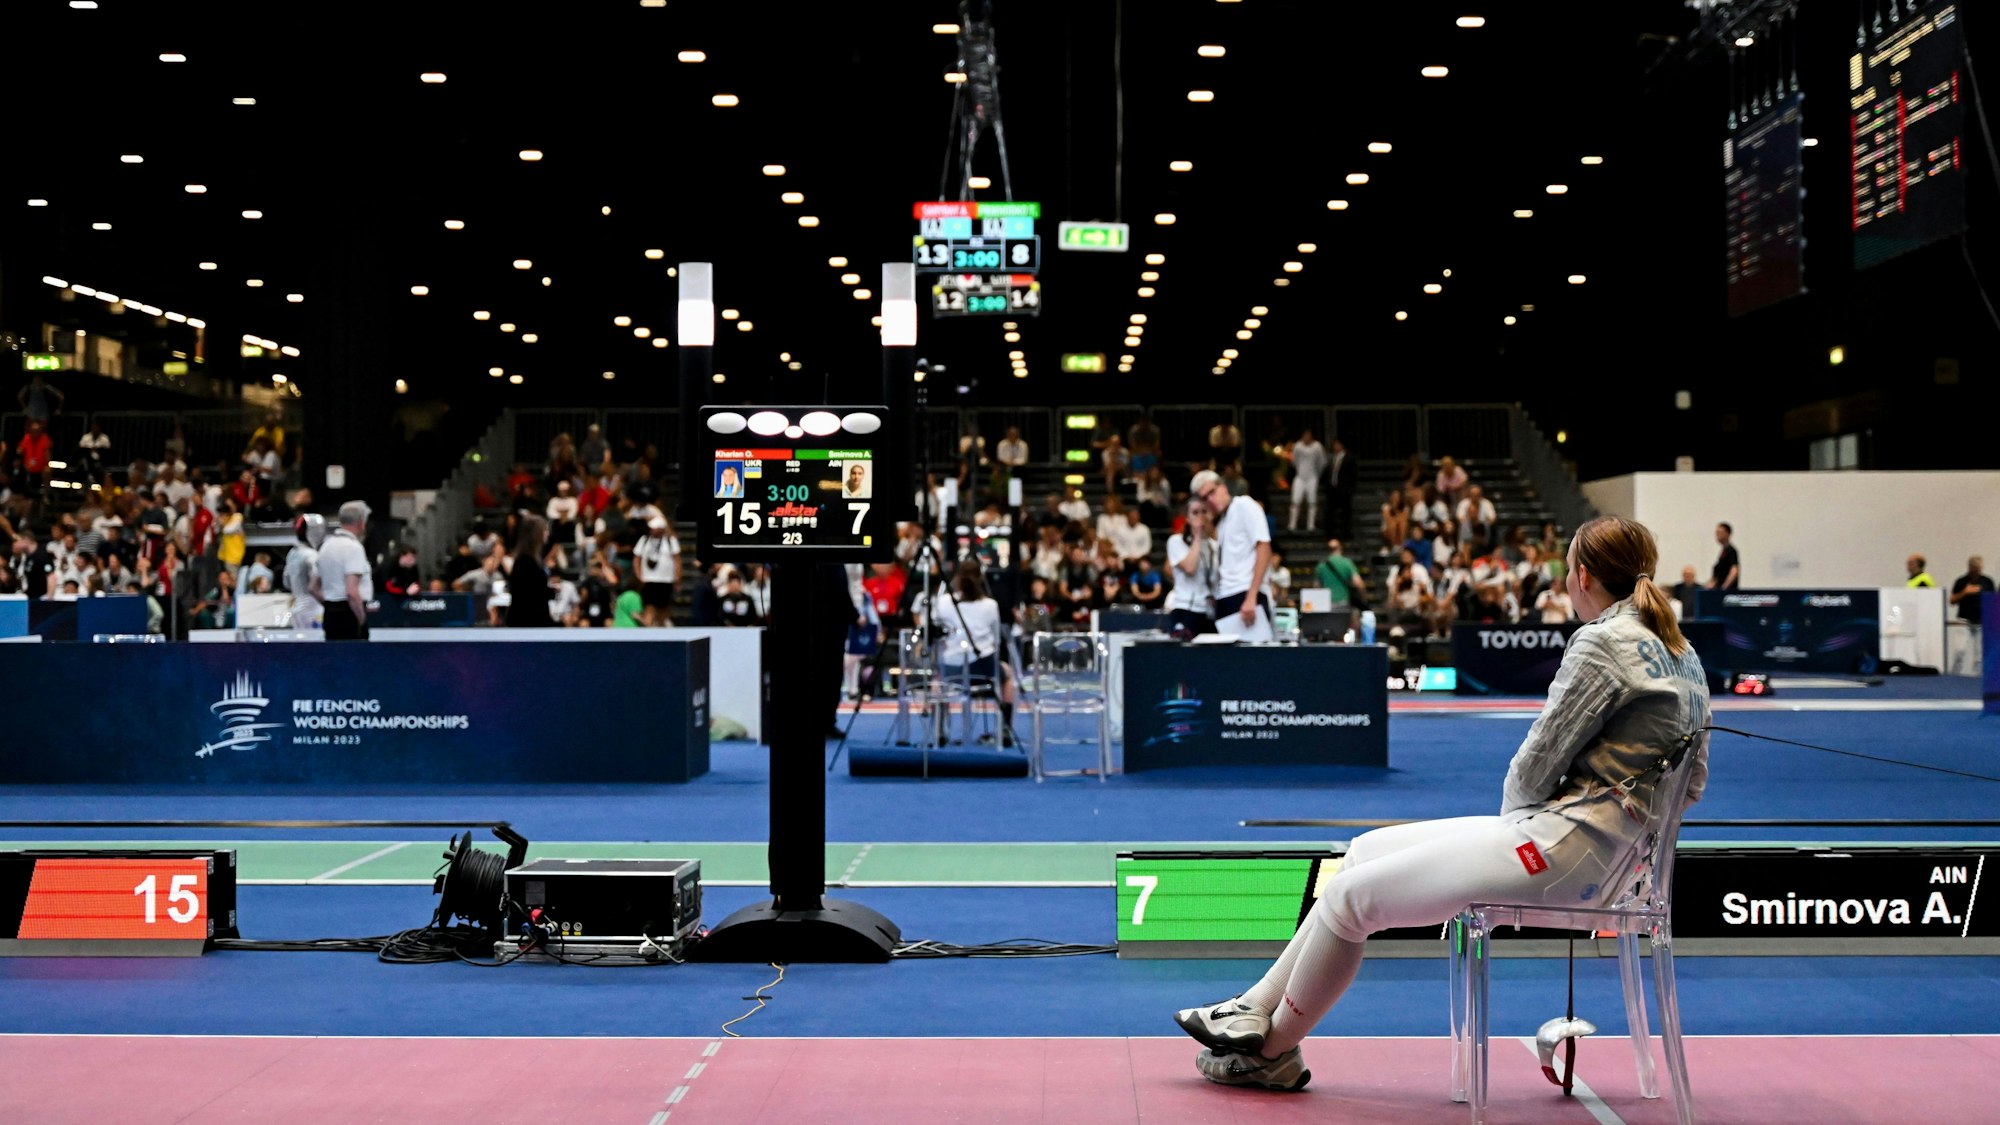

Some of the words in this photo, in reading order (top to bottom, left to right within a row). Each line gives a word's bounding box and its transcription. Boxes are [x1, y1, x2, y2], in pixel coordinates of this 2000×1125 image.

[918, 244, 948, 264] 13
[954, 250, 1000, 267] 3:00
[1012, 244, 1029, 264] 8
[937, 291, 964, 310] 12
[968, 296, 1006, 312] 3:00
[1011, 290, 1038, 307] 14
[828, 450, 863, 458] Smirnova
[864, 450, 872, 458] A.
[745, 459, 762, 467] UKR
[767, 485, 809, 501] 3:00
[773, 501, 818, 516] allstar
[716, 502, 762, 535] 15
[848, 502, 870, 535] 7
[782, 532, 803, 545] 2/3
[1478, 630, 1566, 649] TOYOTA
[293, 700, 313, 713] FIE
[315, 700, 381, 713] FENCING
[1221, 700, 1240, 712] FIE
[1241, 700, 1296, 712] FENCING
[294, 715, 346, 729] WORLD
[349, 715, 469, 729] CHAMPIONSHIPS
[1222, 714, 1268, 726] WORLD
[1269, 714, 1371, 726] CHAMPIONSHIPS
[293, 736, 330, 744] MILAN
[334, 736, 361, 744] 2023
[1221, 730, 1253, 739] MILAN
[1929, 866, 1967, 883] AIN
[134, 875, 199, 923] 15
[1125, 875, 1158, 925] 7
[1722, 892, 1911, 925] Smirnova
[1921, 892, 1962, 925] A.
